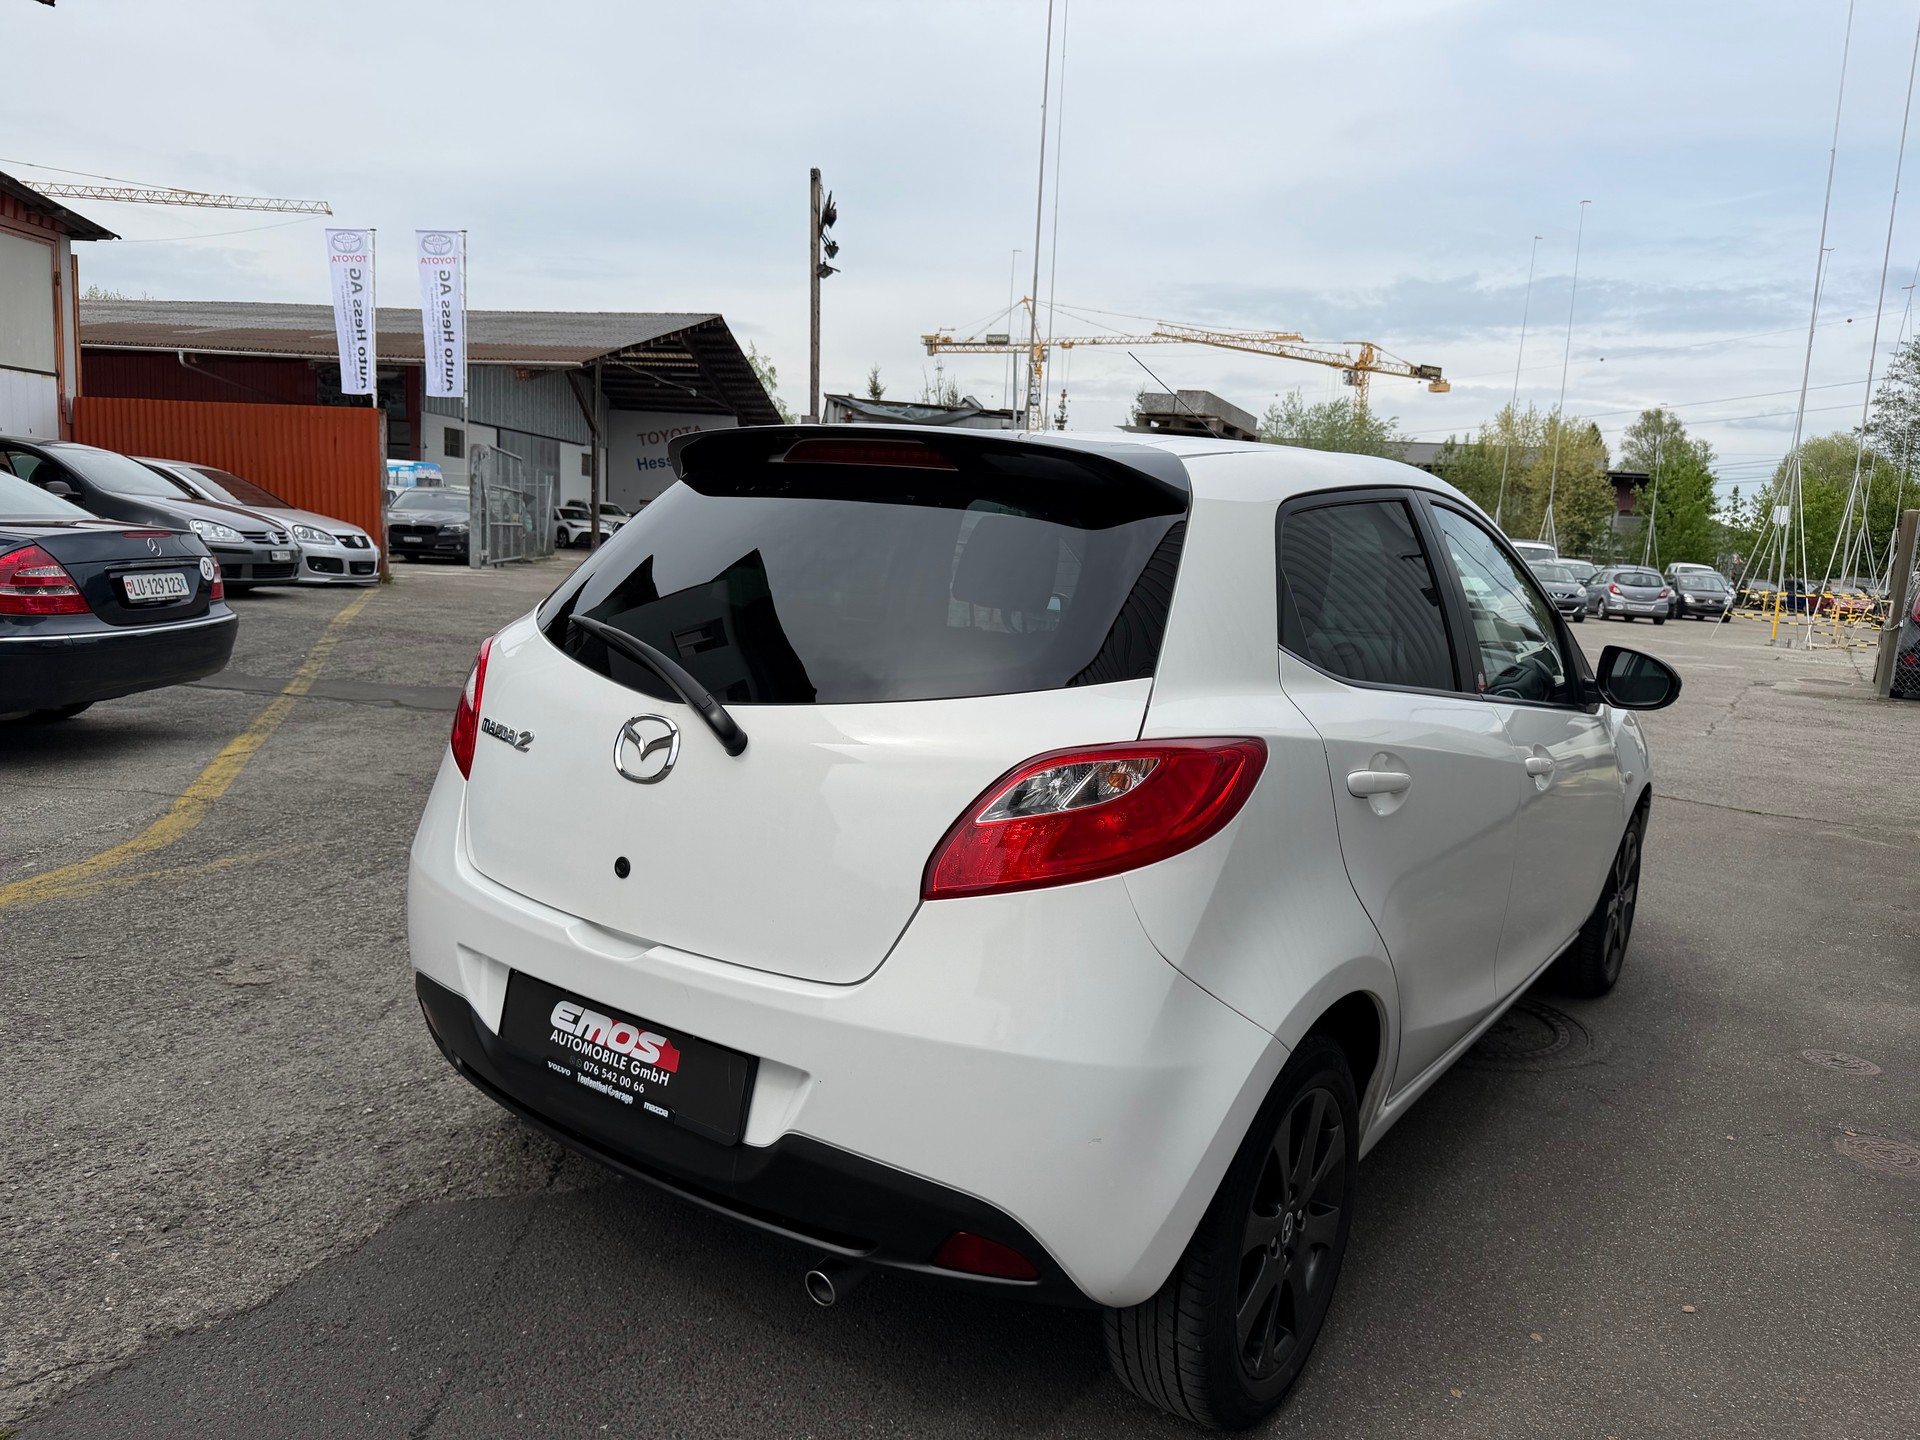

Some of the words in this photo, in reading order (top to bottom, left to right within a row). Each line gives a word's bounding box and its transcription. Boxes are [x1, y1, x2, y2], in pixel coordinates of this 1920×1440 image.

[203, 561, 213, 577] CH
[547, 1061, 571, 1076] VOLVO
[550, 1029, 628, 1070] AUTOMOBILE
[630, 1061, 670, 1086] GmbH
[583, 1061, 599, 1075] 076
[601, 1068, 617, 1083] 542
[619, 1075, 631, 1088] 00
[633, 1081, 645, 1094] 66
